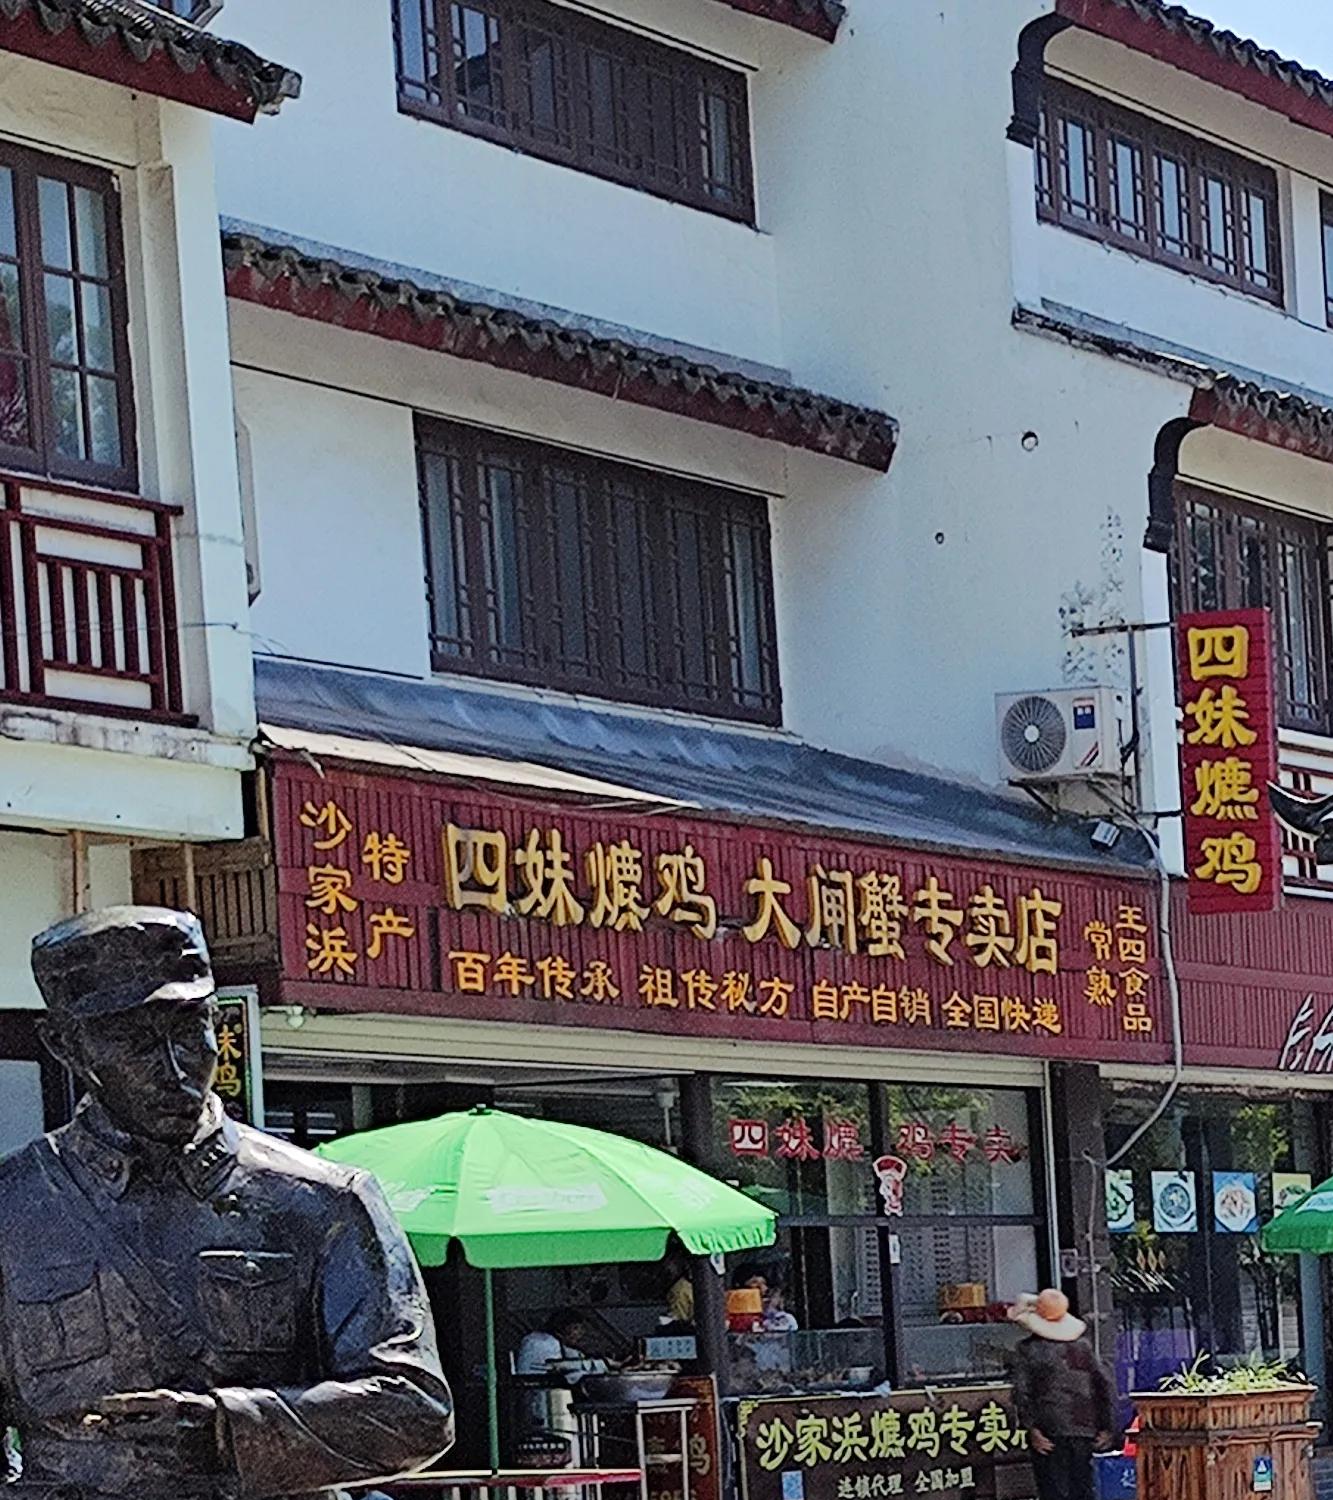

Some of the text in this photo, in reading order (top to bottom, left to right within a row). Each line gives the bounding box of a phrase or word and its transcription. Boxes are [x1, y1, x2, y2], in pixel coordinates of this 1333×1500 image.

[300, 801, 359, 976] 沙家浜
[362, 831, 416, 960] 特产
[742, 857, 1063, 976] 大闸蟹专卖店
[449, 950, 1063, 1035] 百年传承 祖传秘方 自产自销 全国快递
[1083, 920, 1118, 1008] 常熟
[1115, 904, 1153, 1033] 王四食品
[755, 1401, 1029, 1471] 沙家浜爊鸡专卖
